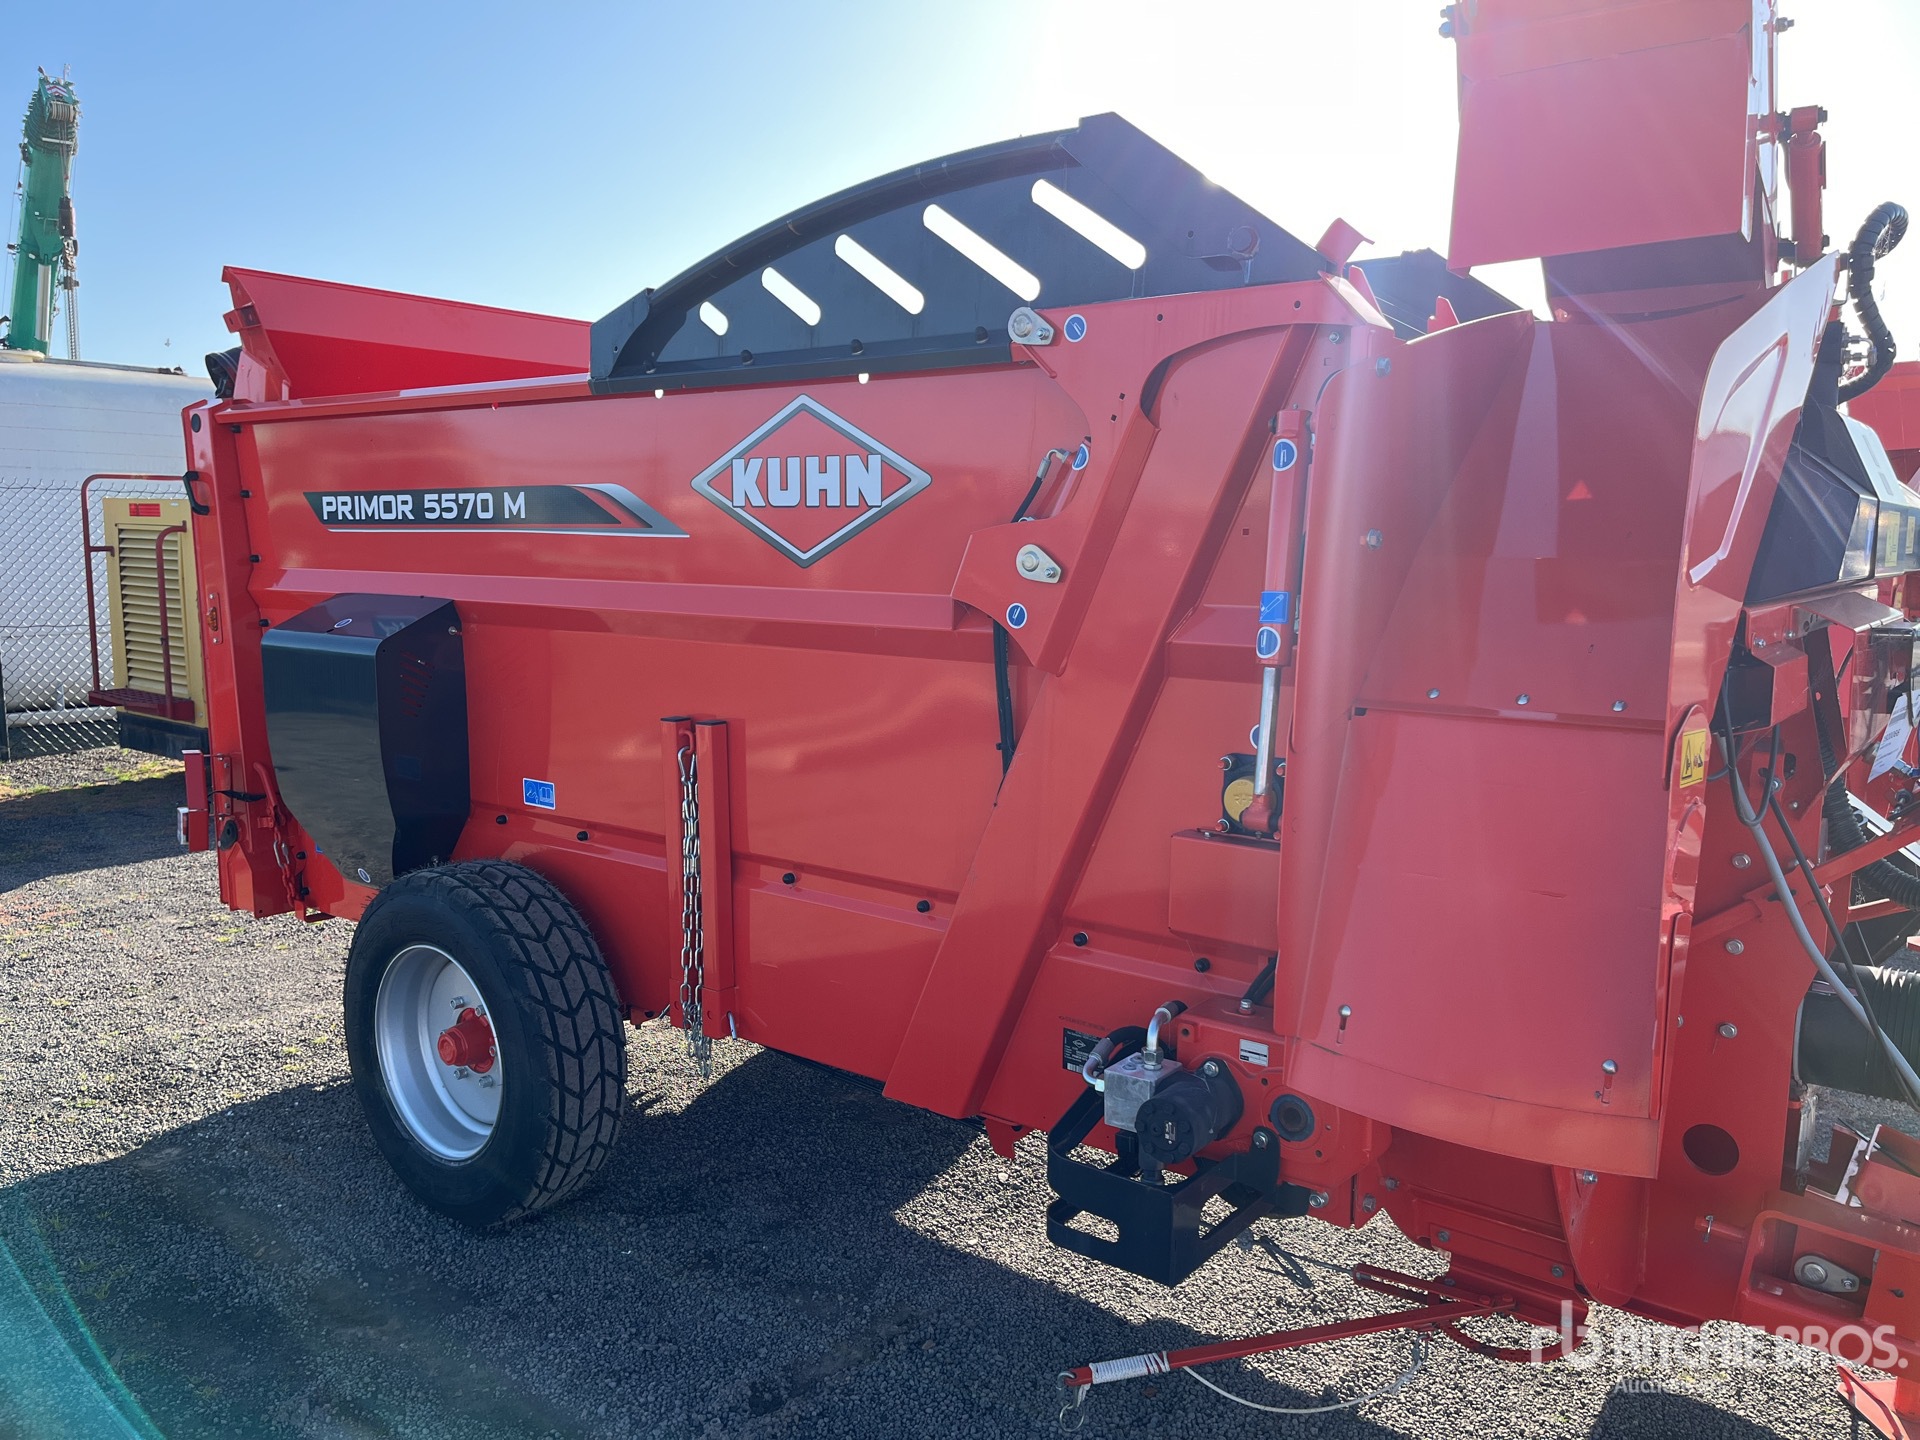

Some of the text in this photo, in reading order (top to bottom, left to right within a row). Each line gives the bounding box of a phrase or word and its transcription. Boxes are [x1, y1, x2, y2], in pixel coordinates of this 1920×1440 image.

[732, 454, 882, 508] KUHN
[322, 491, 526, 520] PRIMOR 5570 M
